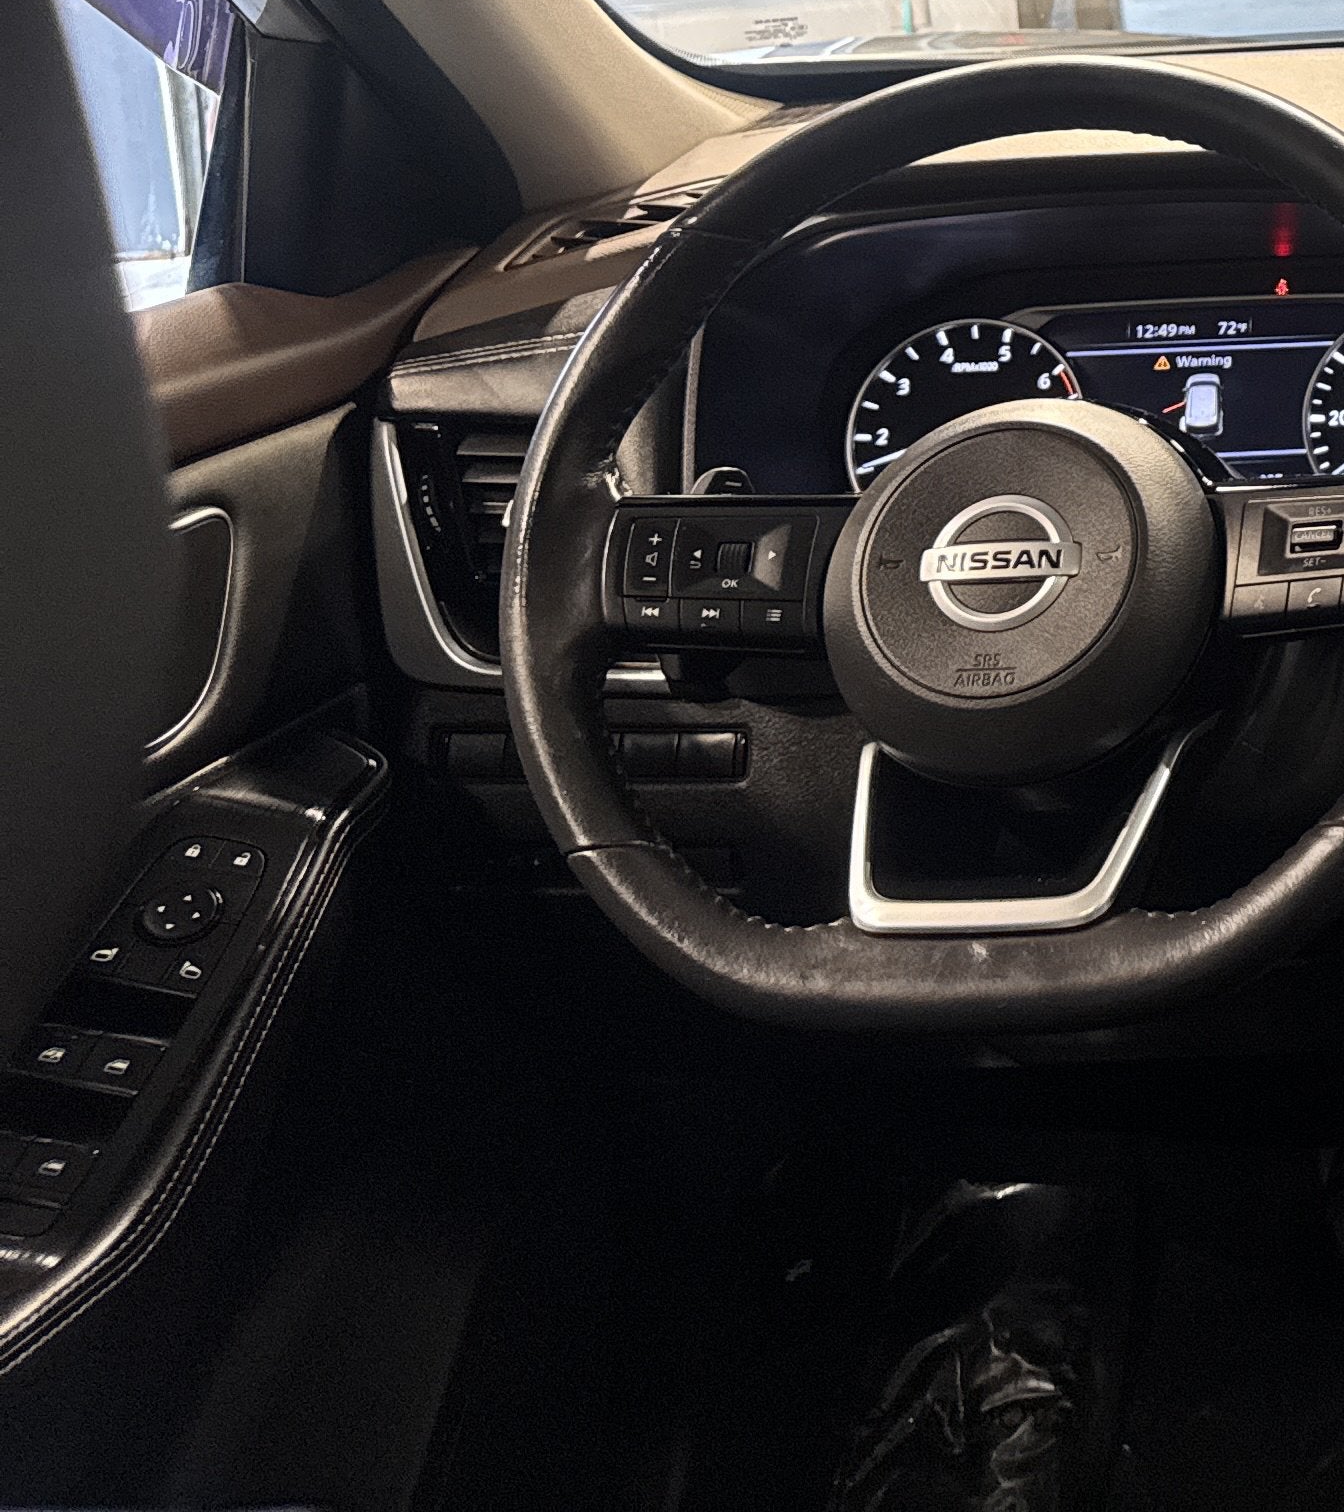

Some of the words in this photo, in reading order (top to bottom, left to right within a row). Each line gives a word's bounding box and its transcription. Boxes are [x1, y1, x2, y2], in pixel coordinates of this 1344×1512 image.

[939, 347, 955, 364] 4
[998, 345, 1012, 362] 5
[1176, 354, 1233, 368] Warning
[895, 378, 911, 396] 3
[1036, 373, 1051, 390] 6
[874, 427, 889, 446] 2
[1294, 529, 1332, 540] CANCEL
[936, 548, 1063, 573] NISSAN
[721, 578, 740, 588] OK
[972, 653, 1001, 667] SRS
[953, 672, 1016, 687] AIRBAG
